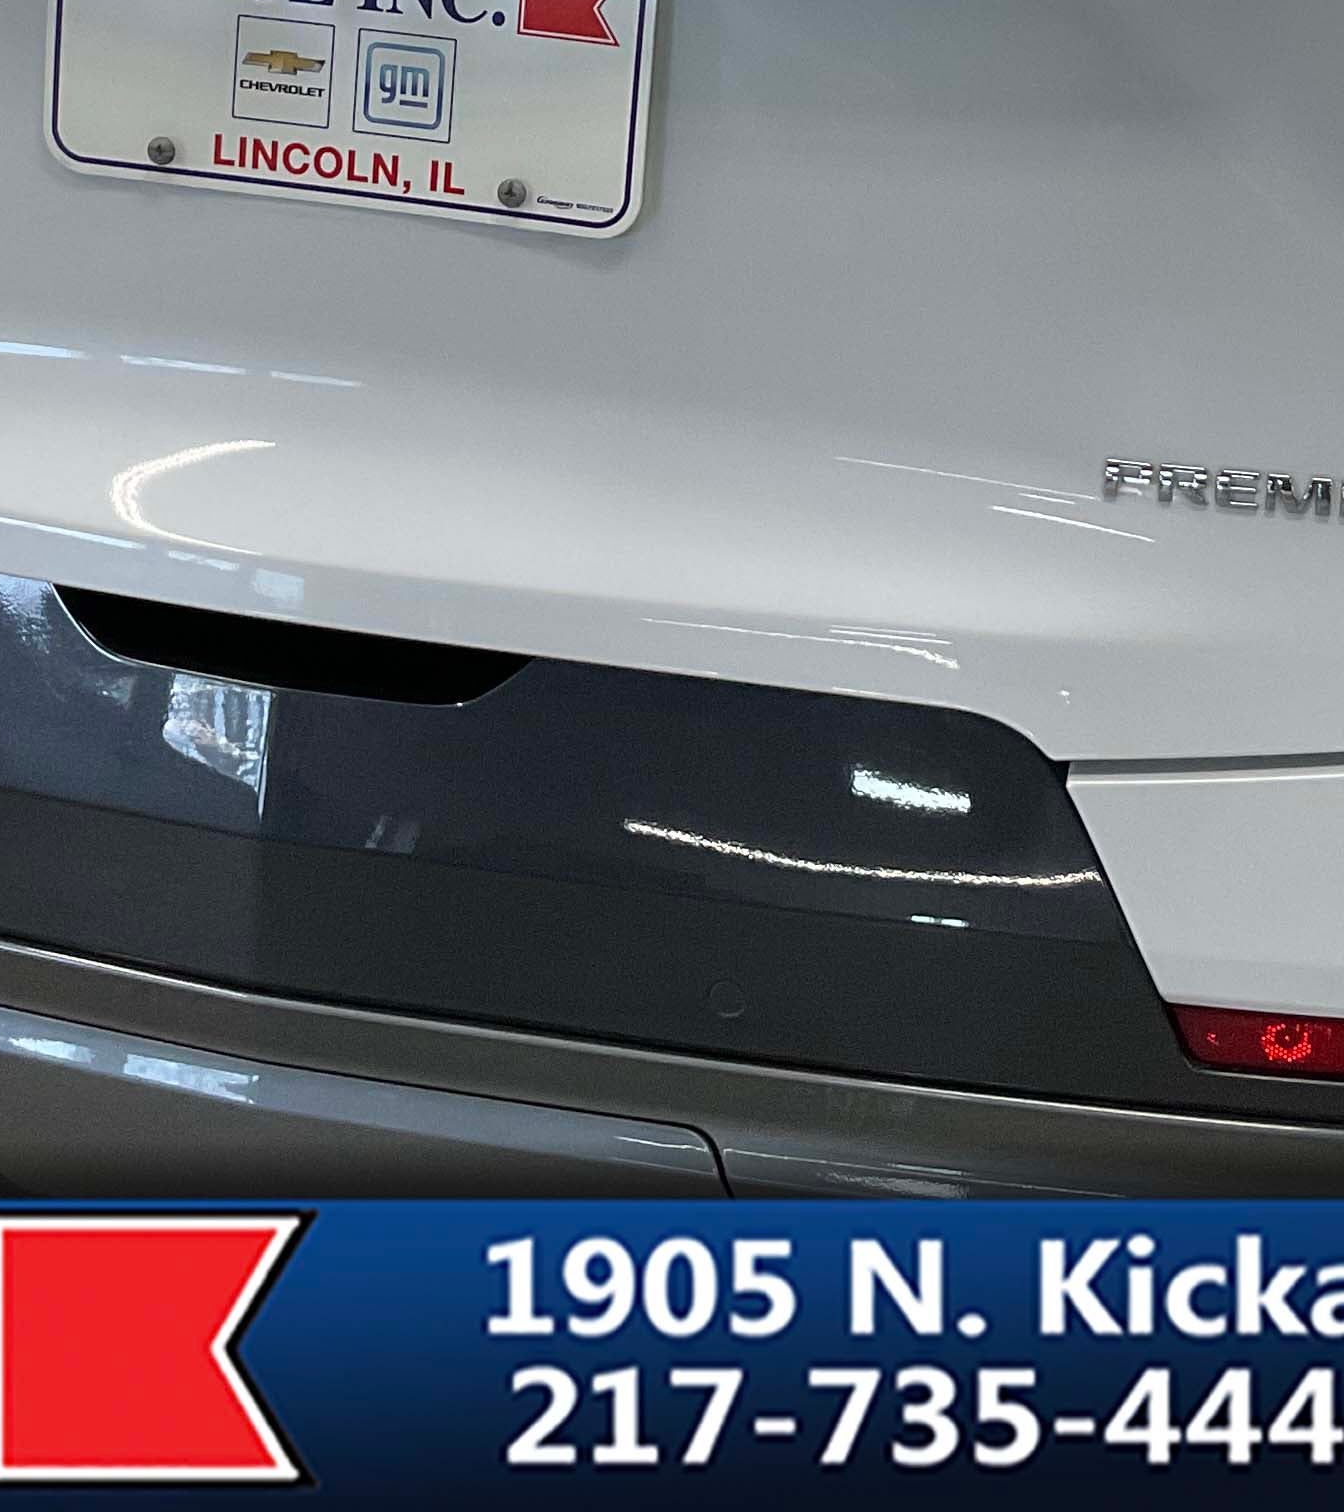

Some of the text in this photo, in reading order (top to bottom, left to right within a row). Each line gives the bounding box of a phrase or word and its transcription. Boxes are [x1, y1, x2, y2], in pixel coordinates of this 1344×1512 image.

[239, 78, 325, 98] CHEVROLET
[378, 62, 430, 106] gm
[212, 133, 465, 195] LINCOLN, IL
